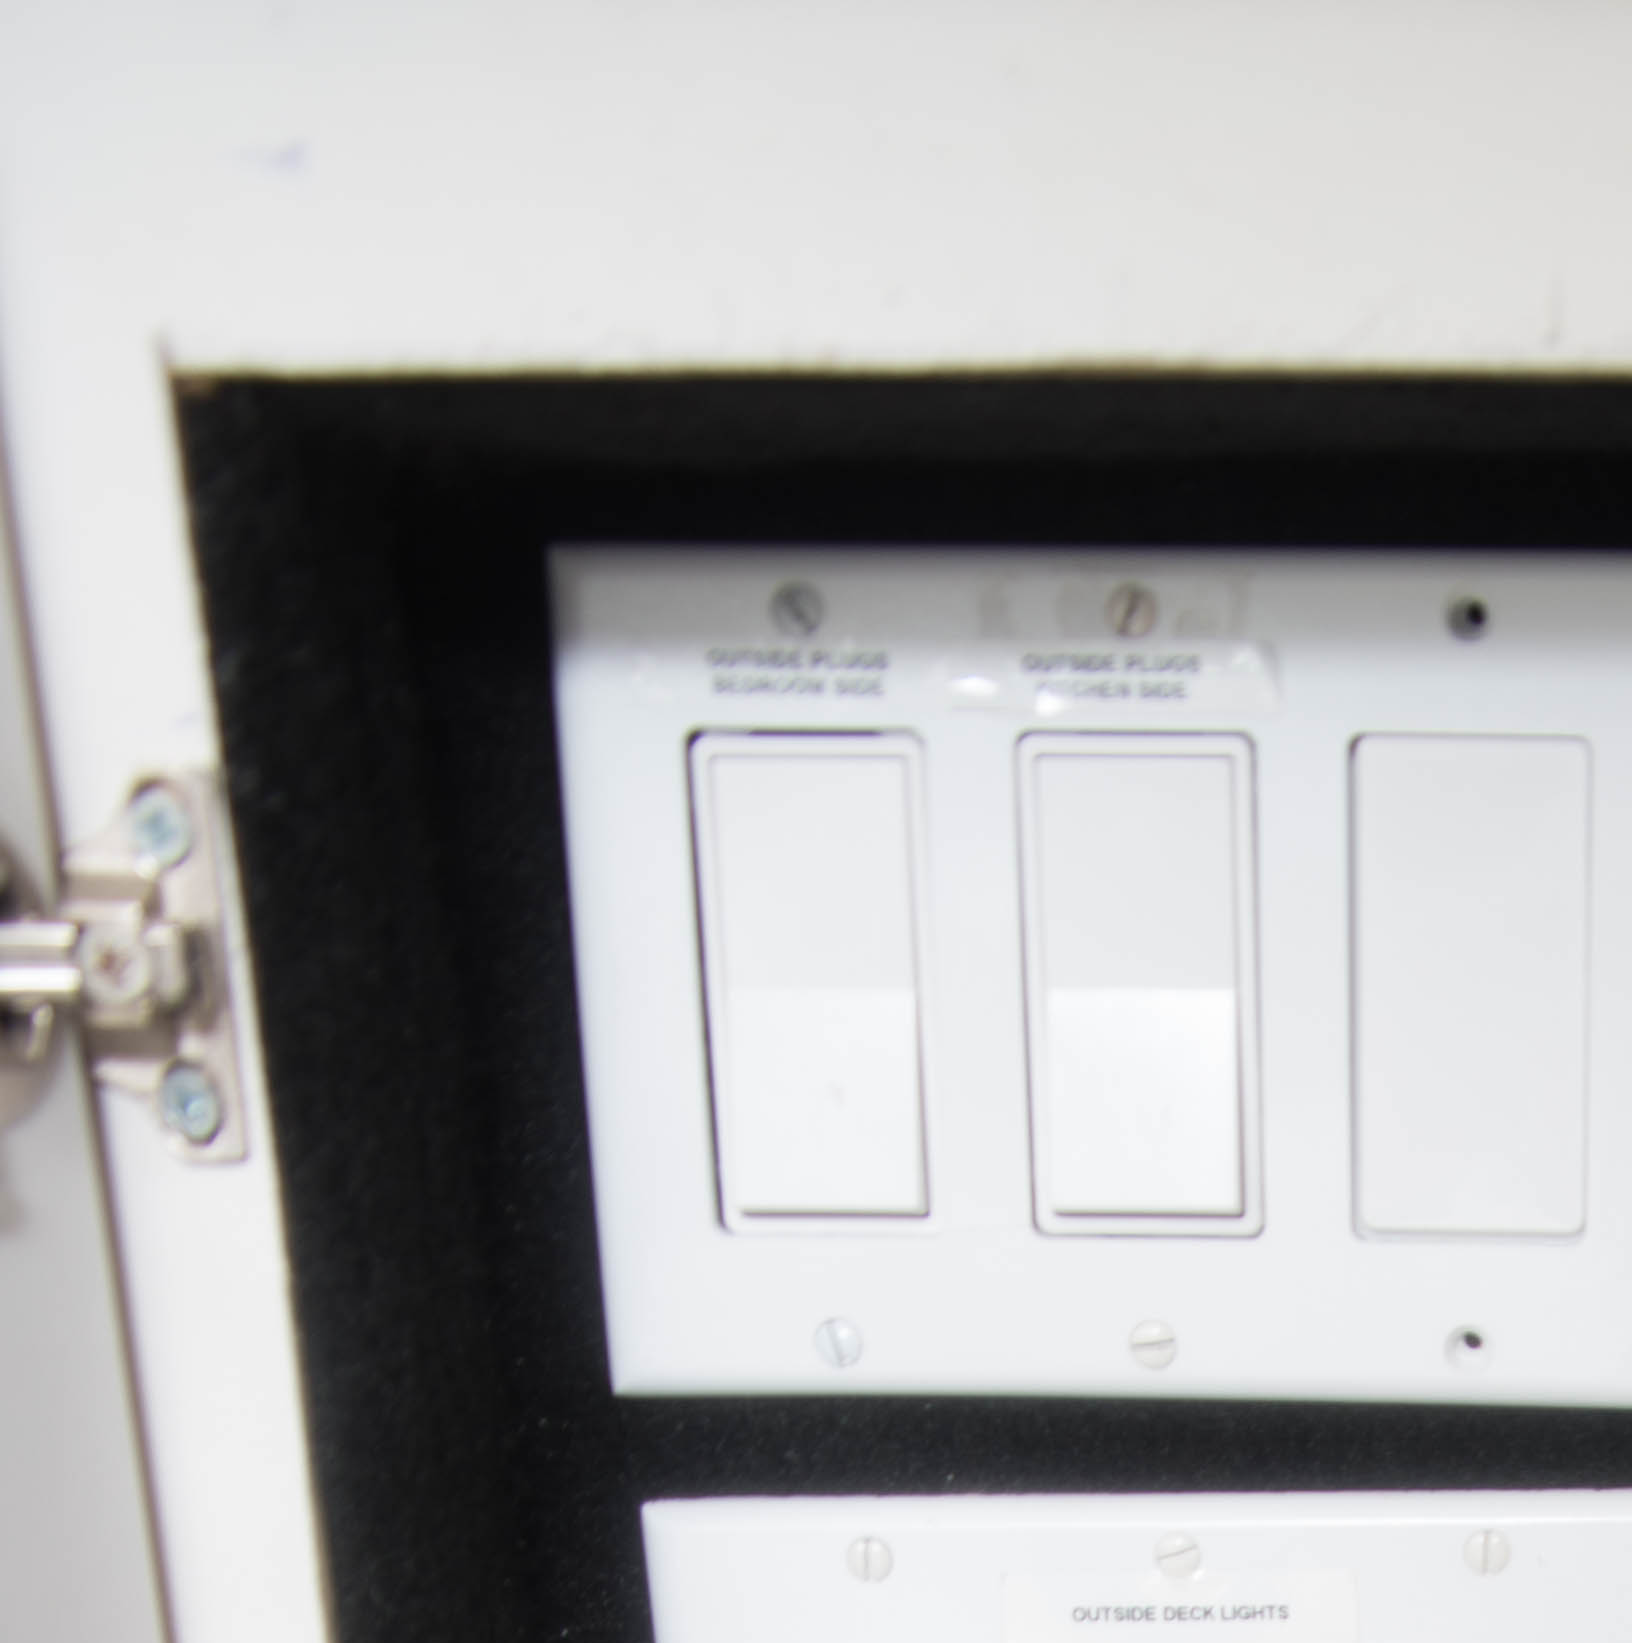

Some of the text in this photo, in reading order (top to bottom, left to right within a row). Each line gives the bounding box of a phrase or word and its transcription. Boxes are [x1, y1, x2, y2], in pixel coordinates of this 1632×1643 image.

[1020, 654, 1119, 672] OUTSIDE
[1072, 1604, 1290, 1622] OUTSIDE DECK LIGHTS
